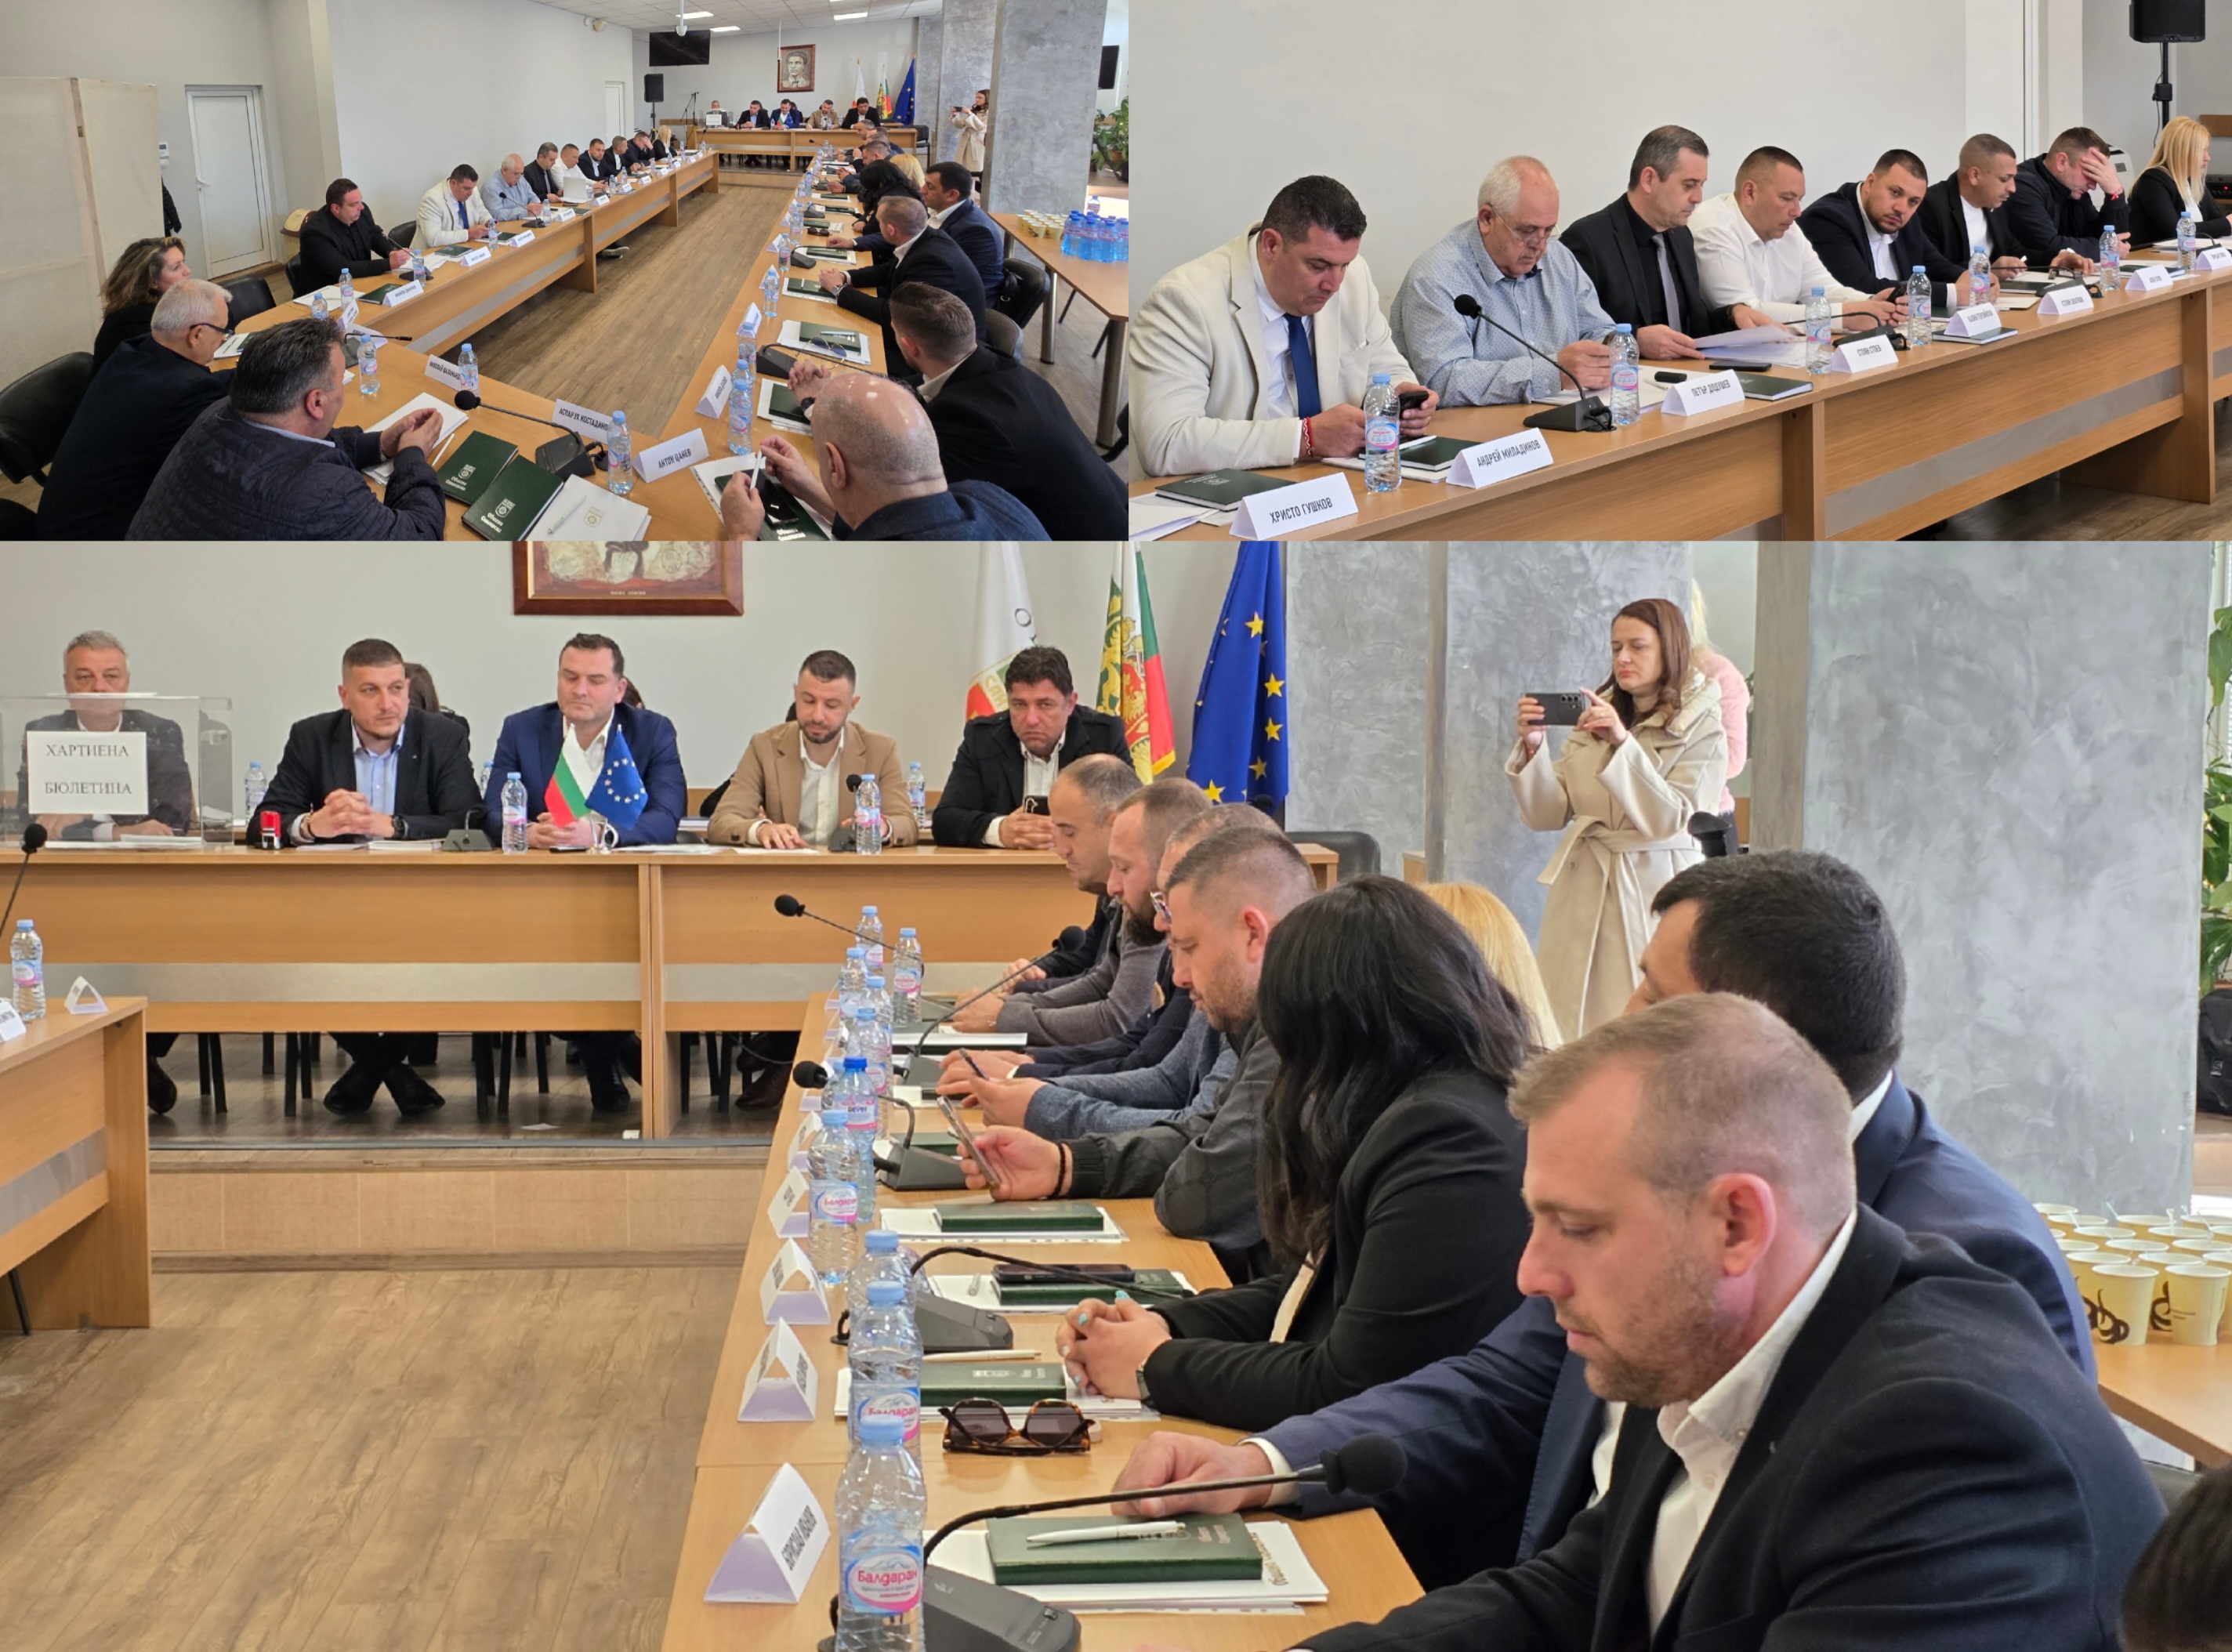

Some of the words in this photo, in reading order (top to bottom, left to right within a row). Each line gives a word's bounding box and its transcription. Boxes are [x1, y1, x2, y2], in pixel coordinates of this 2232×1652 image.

[1857, 347, 1870, 357] СТОЯН
[1870, 344, 1882, 354] СТОЕВ
[429, 361, 444, 371] НИКОЛАЙ
[443, 367, 461, 380] ШАЛАМАНД
[1691, 386, 1708, 397] ПЕТЪР
[559, 408, 580, 422] АСПАРУХ
[581, 413, 608, 432] КОСТАДИНО
[658, 454, 675, 469] АНТОН
[675, 447, 692, 463] ЦАНЕВ
[1477, 448, 1501, 468] АНДРЕЙ
[1502, 440, 1542, 461] МИЛАДИНОВ
[1269, 506, 1301, 523] ХРИСТО
[1302, 497, 1333, 516] ГУШКОВ
[46, 744, 129, 757] ХАРТИЕНА
[45, 782, 132, 795] БЮЛЕТИНА
